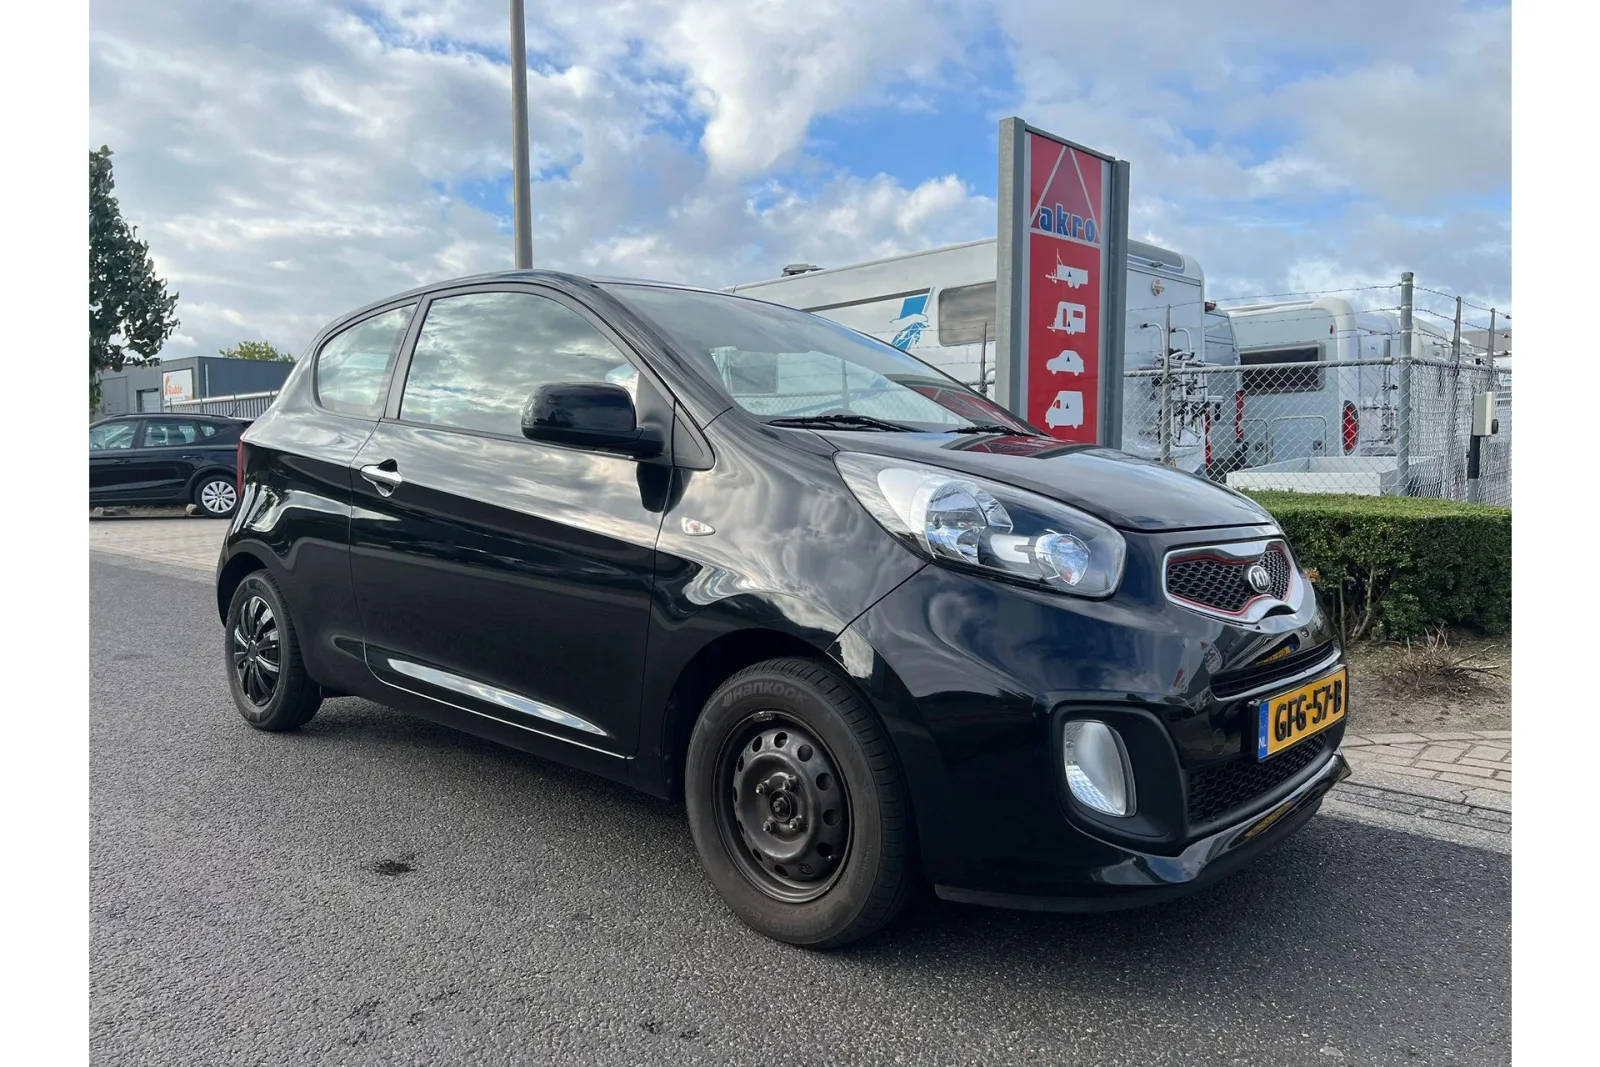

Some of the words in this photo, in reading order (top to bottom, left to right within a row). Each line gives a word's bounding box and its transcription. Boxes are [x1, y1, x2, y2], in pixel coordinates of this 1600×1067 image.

[1039, 203, 1097, 243] akro
[1275, 680, 1342, 742] GFG-57-B
[1258, 735, 1266, 749] NL
